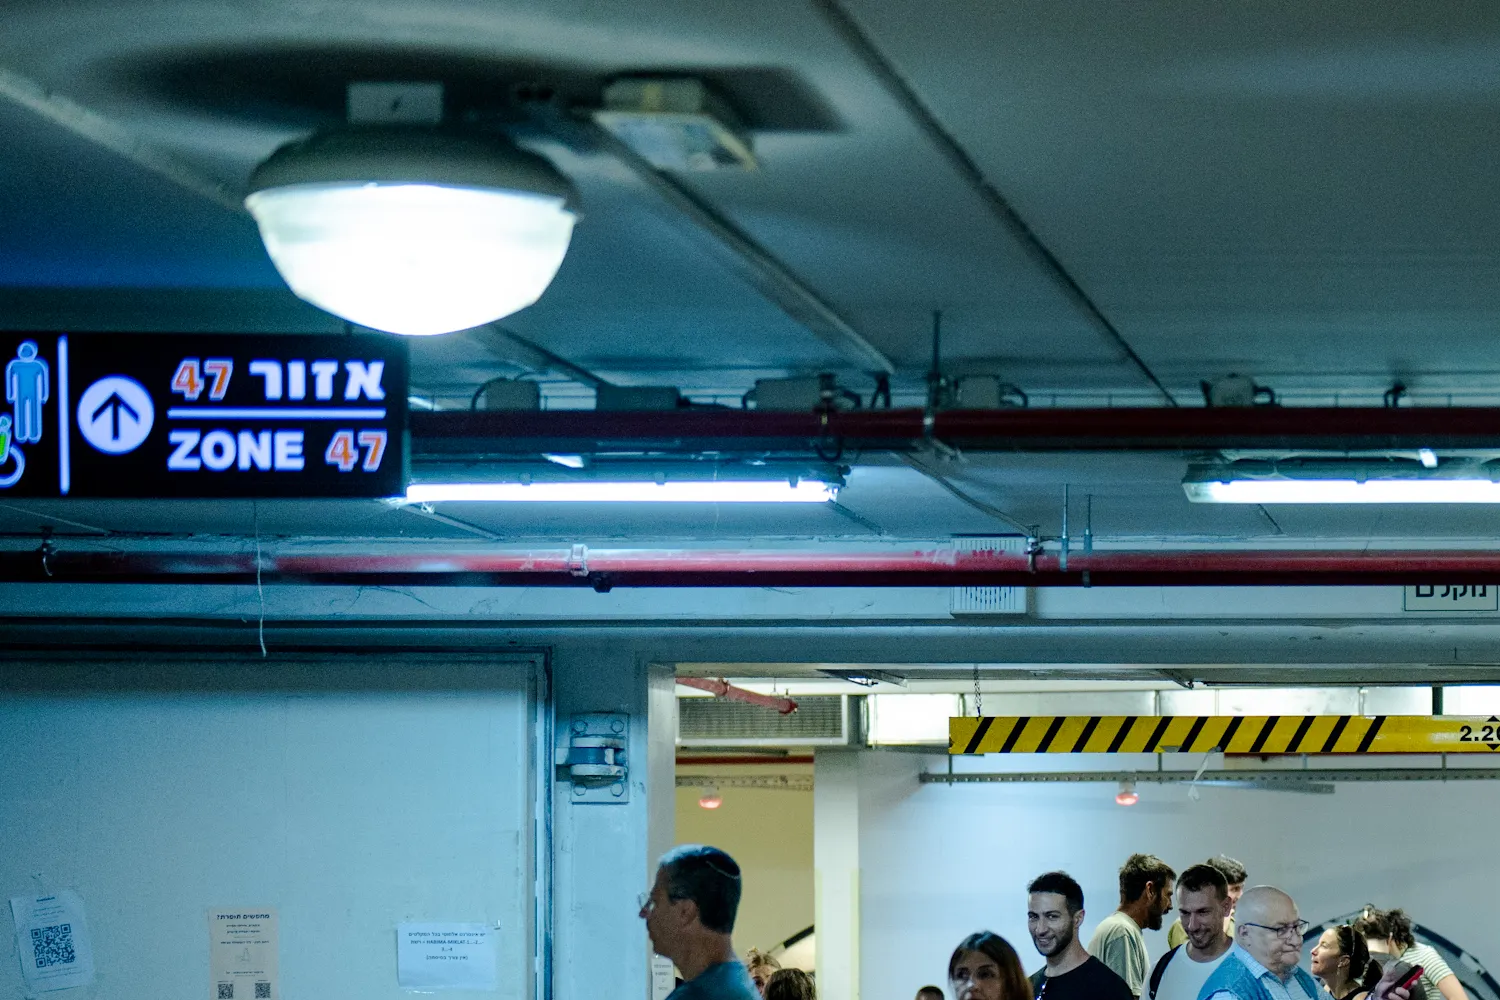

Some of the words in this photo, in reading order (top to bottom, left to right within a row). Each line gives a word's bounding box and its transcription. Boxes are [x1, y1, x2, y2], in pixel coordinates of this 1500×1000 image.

[171, 359, 234, 401] 47
[249, 360, 386, 400] אזור
[166, 430, 305, 471] ZONE
[325, 430, 388, 472] 47
